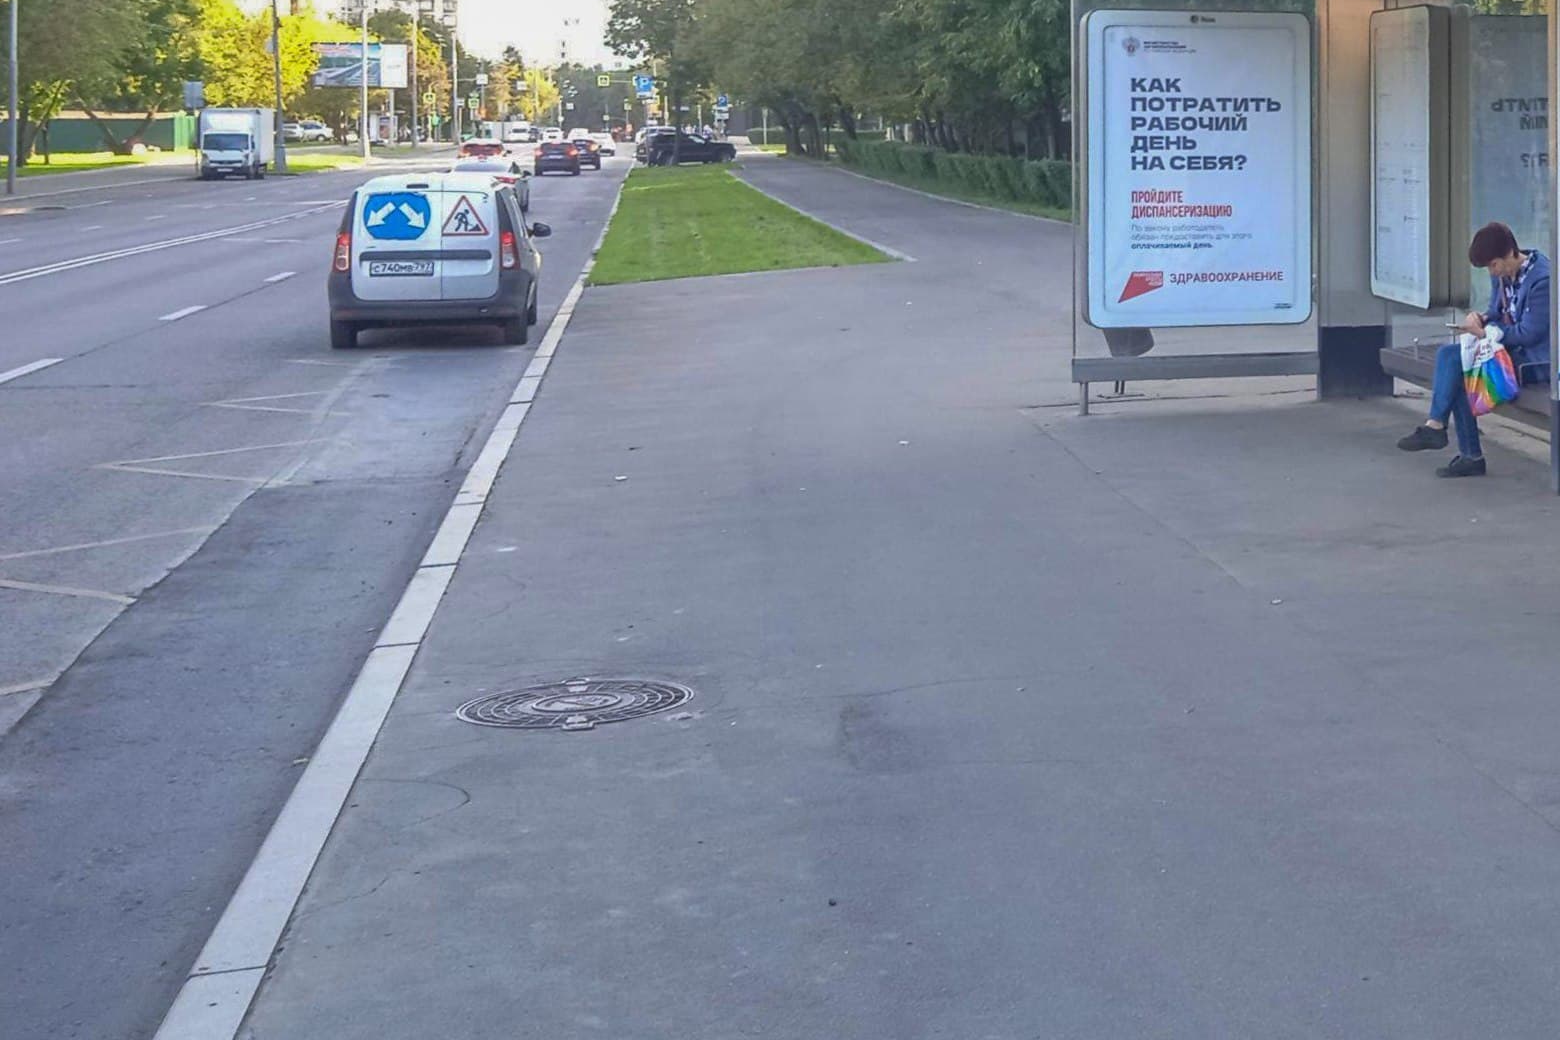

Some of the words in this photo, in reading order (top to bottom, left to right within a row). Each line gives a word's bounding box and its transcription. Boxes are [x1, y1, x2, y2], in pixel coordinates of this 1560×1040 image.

[1130, 77, 1181, 93] КАК
[1130, 96, 1282, 112] ПОТРАТИТЬ
[1130, 113, 1248, 131] РАБОЧИЙ
[1130, 135, 1197, 153] ДЕНЬ
[1131, 155, 1165, 171] НА
[1169, 154, 1248, 171] СЕБЯ?
[1131, 189, 1184, 204] ПРОЙДИТЕ
[1131, 204, 1233, 220] ДИСПАНСЕРИЗАЦИЮ
[1169, 271, 1284, 285] ЗДРАВООХРАНЕНИЕ
